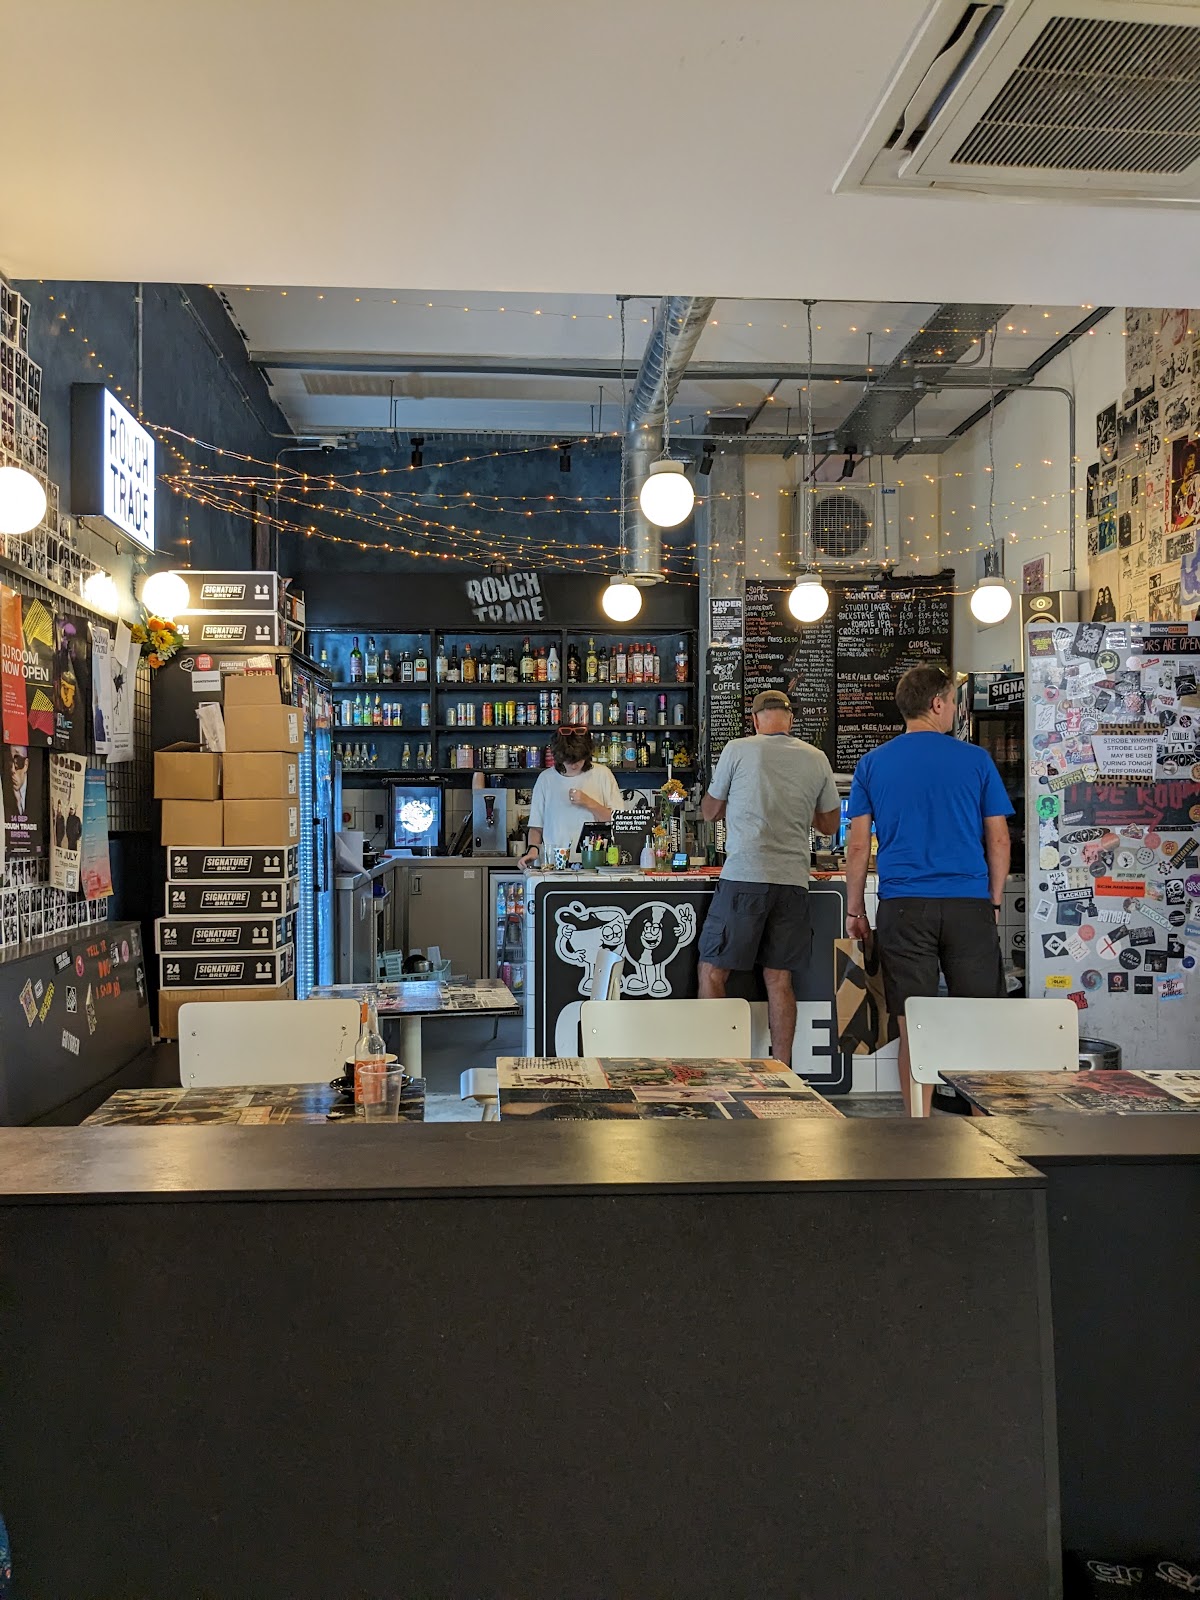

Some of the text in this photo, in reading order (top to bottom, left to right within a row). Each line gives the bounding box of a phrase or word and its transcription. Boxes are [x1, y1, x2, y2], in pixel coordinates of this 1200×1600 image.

[109, 407, 149, 488] ROUGH
[110, 462, 149, 540] TRADE
[204, 585, 243, 594] SIGNATURE
[465, 572, 541, 606] ROUGH
[844, 591, 887, 600] SIGNATURE
[712, 600, 742, 608] UNDER
[844, 603, 868, 611] STUDIO
[870, 602, 892, 612] LAGER
[472, 596, 546, 624] TRADE
[838, 611, 874, 620] BACKSTAGE
[878, 611, 890, 620] IPA
[851, 620, 875, 628] ROADIE
[877, 619, 891, 629] IPA
[177, 624, 190, 635] 24
[205, 626, 244, 634] SIGNATURE
[882, 628, 895, 636] IPA
[1144, 637, 1200, 651] ORS ARE OPEN
[2, 643, 39, 666] DJ ROOM
[2, 659, 49, 682] NOW OPEN
[873, 673, 890, 681] CANS
[712, 682, 741, 692] COFFEE
[802, 707, 828, 715] SHOTS
[20, 823, 38, 831] TRADE
[63, 850, 78, 862] JULY
[174, 856, 188, 866] 24
[206, 857, 249, 866] SIGNATURE
[172, 891, 186, 901] 24
[204, 893, 247, 901] SIGNATURE
[164, 928, 177, 939] 24
[196, 929, 238, 938] SIGNATURE
[86, 944, 100, 957] TELL
[167, 963, 180, 974] 24
[199, 965, 240, 973] SIGNATURE
